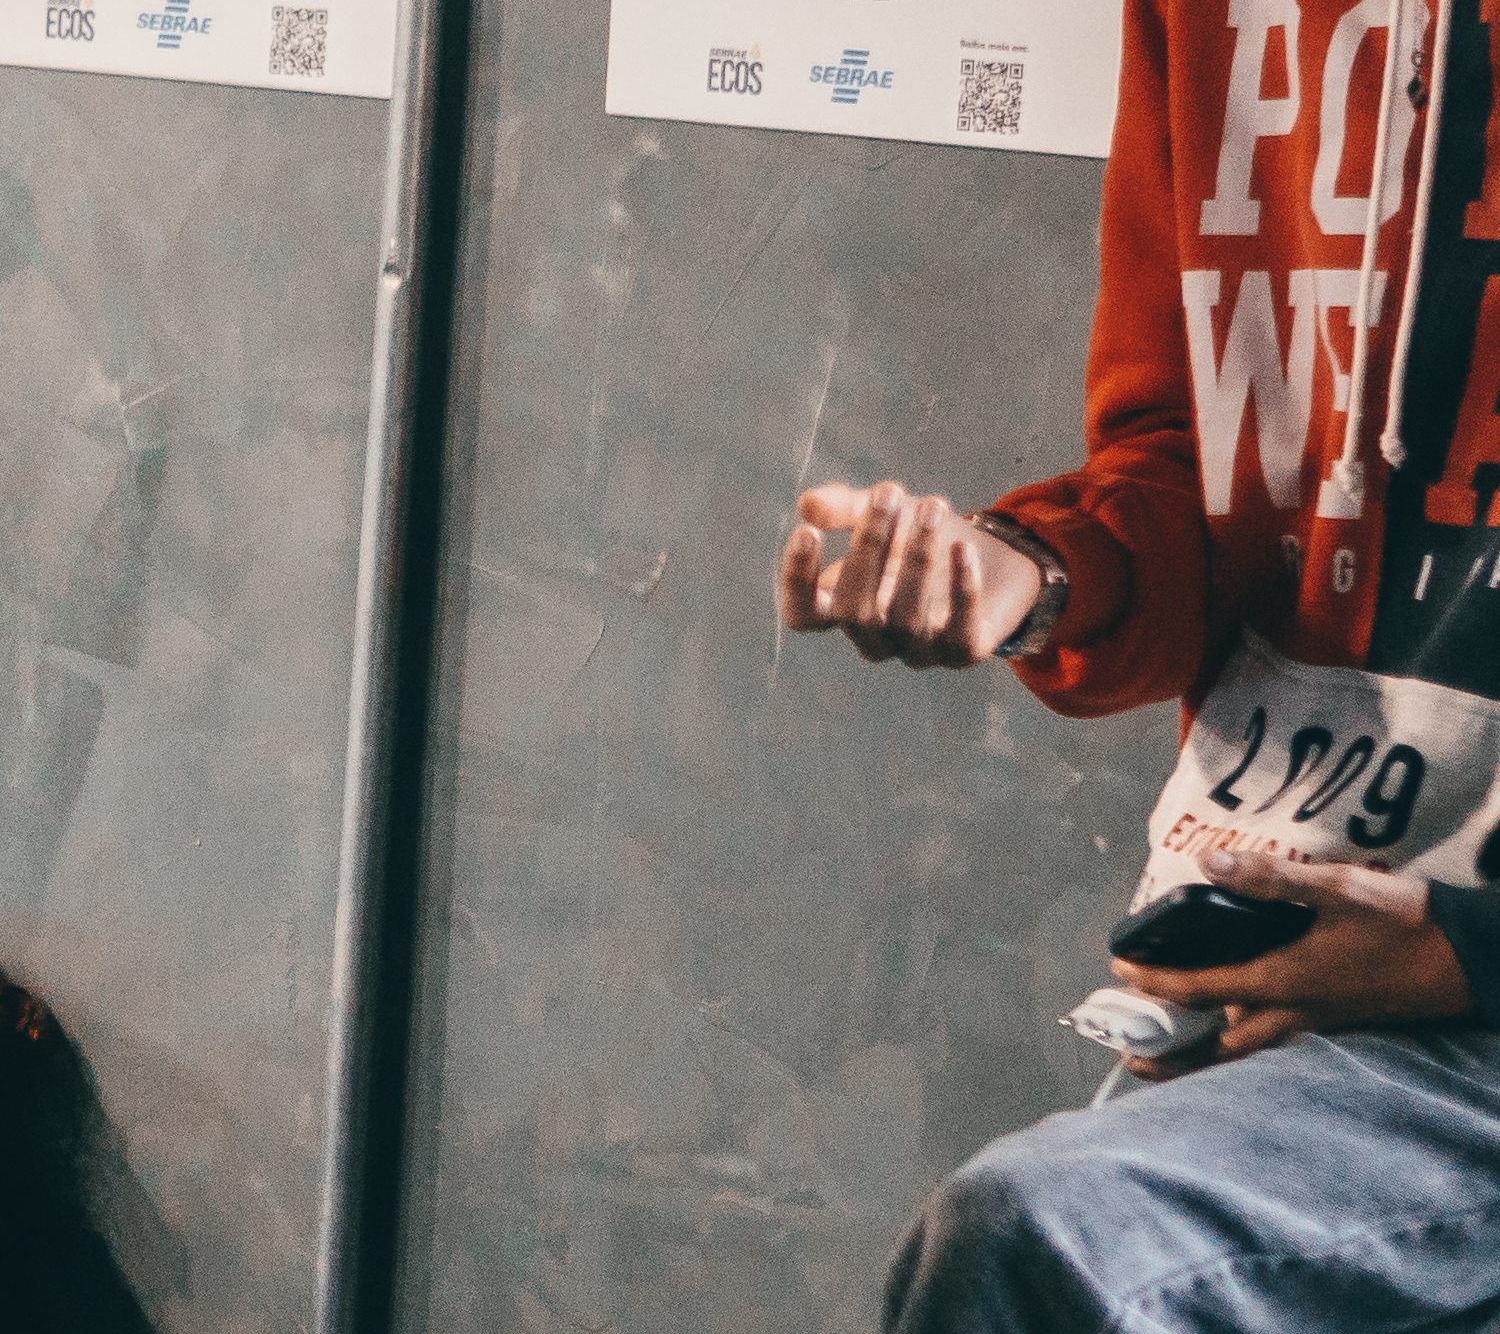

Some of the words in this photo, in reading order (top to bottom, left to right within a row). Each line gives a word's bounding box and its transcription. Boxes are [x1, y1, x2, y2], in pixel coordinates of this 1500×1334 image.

[46, 8, 95, 41] ECOS
[137, 12, 213, 35] SEBRAE
[707, 59, 763, 95] ECOS
[809, 65, 895, 89] SEBRAE
